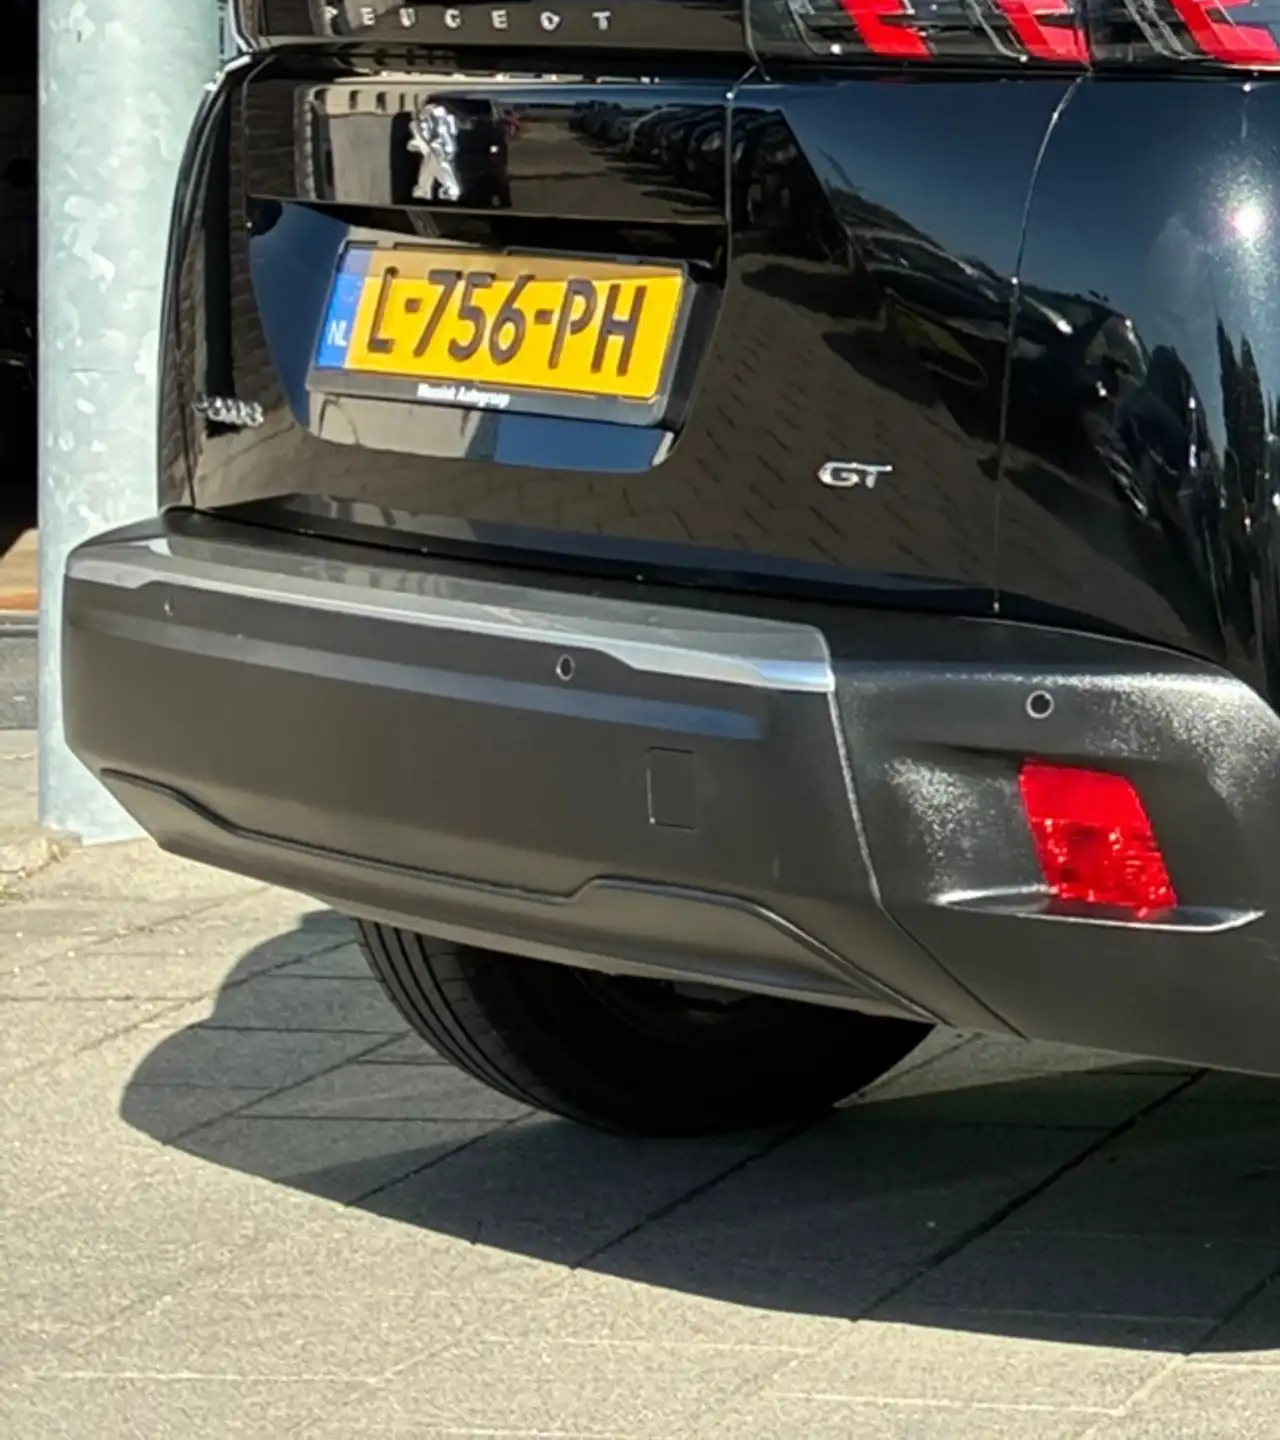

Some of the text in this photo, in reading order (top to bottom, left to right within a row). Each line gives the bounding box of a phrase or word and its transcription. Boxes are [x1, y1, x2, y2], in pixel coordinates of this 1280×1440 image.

[322, 6, 612, 34] PEUGEOT
[327, 320, 348, 348] NL
[366, 265, 648, 377] L-756-PH
[816, 461, 894, 489] GT
